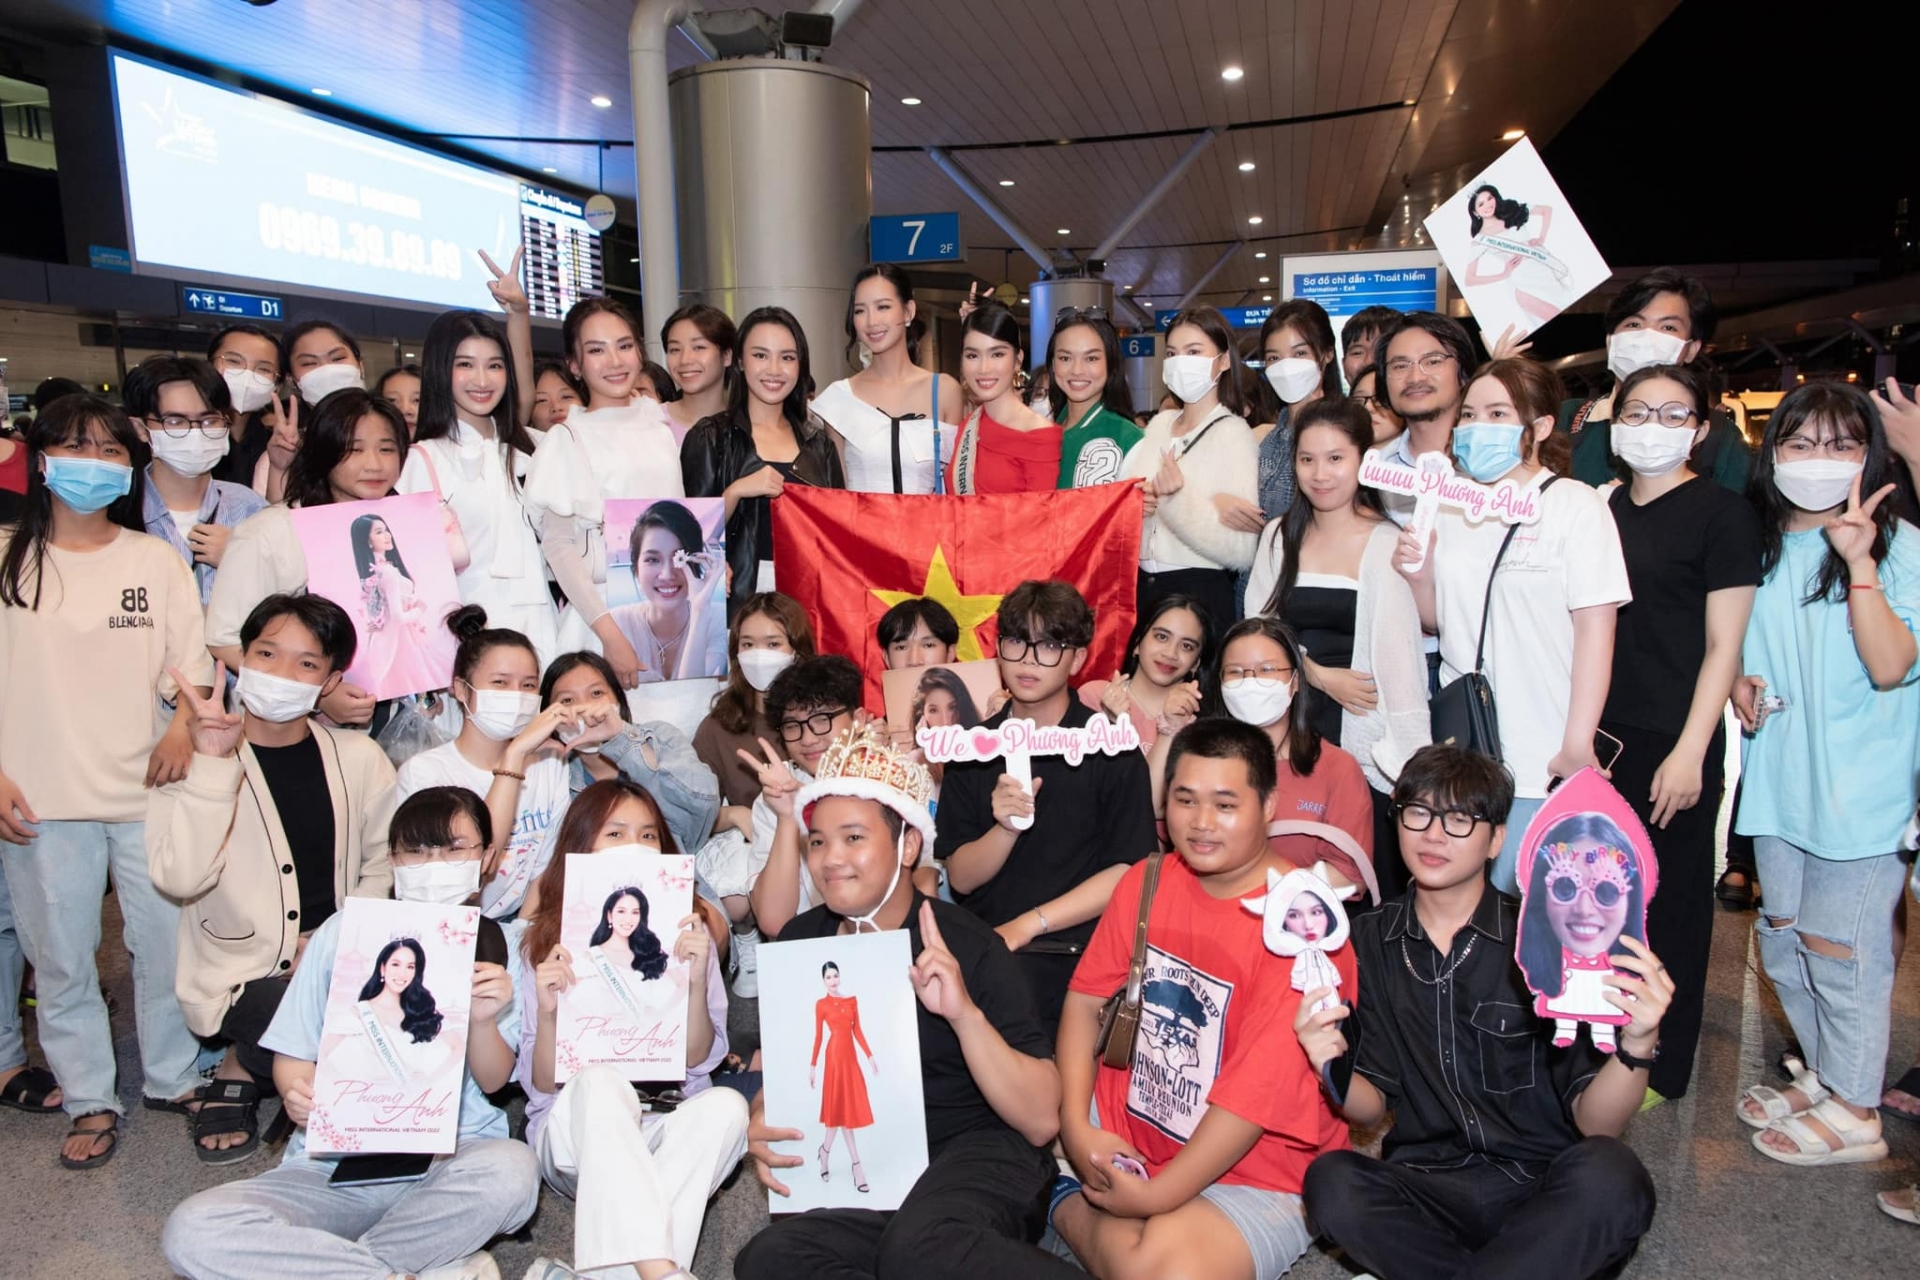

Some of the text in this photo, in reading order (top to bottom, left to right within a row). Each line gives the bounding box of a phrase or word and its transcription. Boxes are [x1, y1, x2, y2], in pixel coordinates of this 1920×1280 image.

[902, 220, 926, 255] 7
[940, 244, 953, 254] 2F
[1303, 277, 1317, 286] Sơ
[261, 300, 278, 316] D1
[1129, 339, 1139, 355] 6
[959, 454, 968, 495] INTERN
[1418, 470, 1486, 517] Phương
[1491, 485, 1535, 518] Anh
[921, 718, 1135, 761] We Phương Anh
[1161, 966, 1189, 981] ROOTS
[1200, 989, 1220, 1018] DEEP
[612, 1020, 681, 1056] Anh
[373, 1087, 453, 1125] Anh
[1157, 1085, 1193, 1118] REUNION
